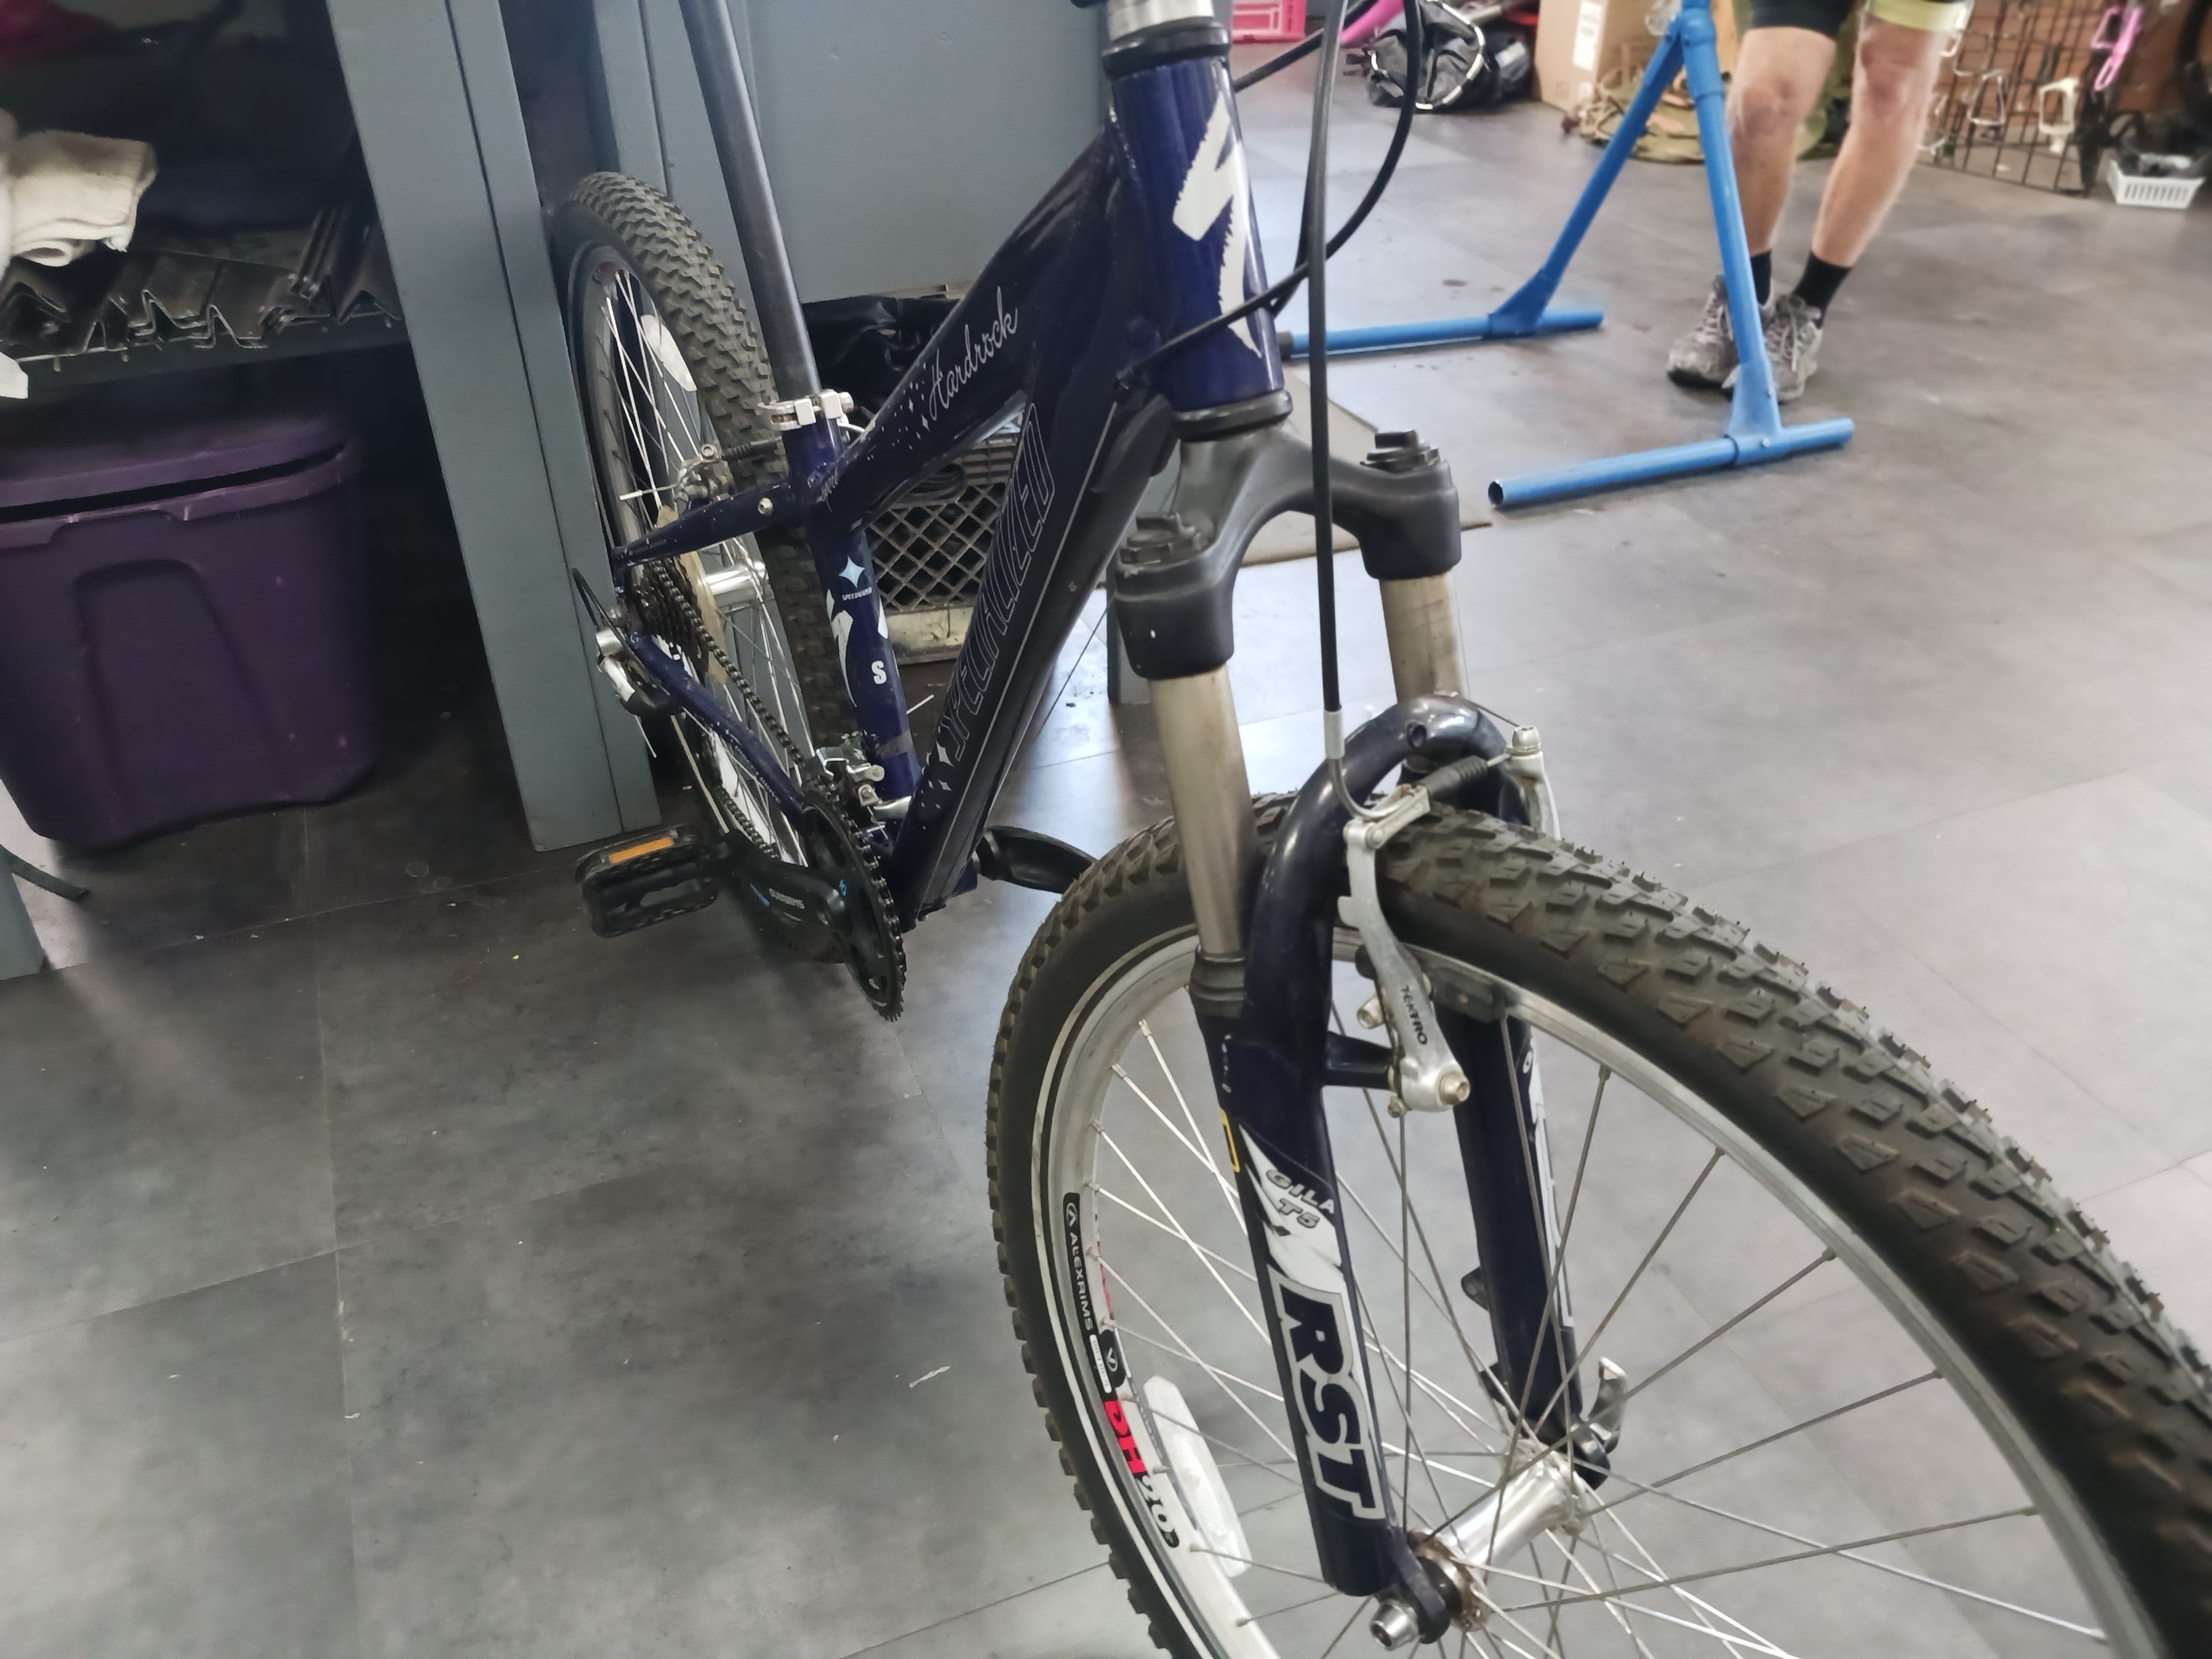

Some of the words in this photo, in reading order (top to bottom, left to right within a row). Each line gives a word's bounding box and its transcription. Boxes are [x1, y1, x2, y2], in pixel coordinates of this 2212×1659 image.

[929, 285, 1019, 422] Hardrock
[871, 660, 887, 684] S
[1401, 984, 1428, 1045] TEKTRO
[1266, 1169, 1335, 1214] GILA
[1279, 1197, 1321, 1229] T5
[1069, 1231, 1094, 1331] ALEXRIMS
[1276, 1279, 1380, 1512] RST
